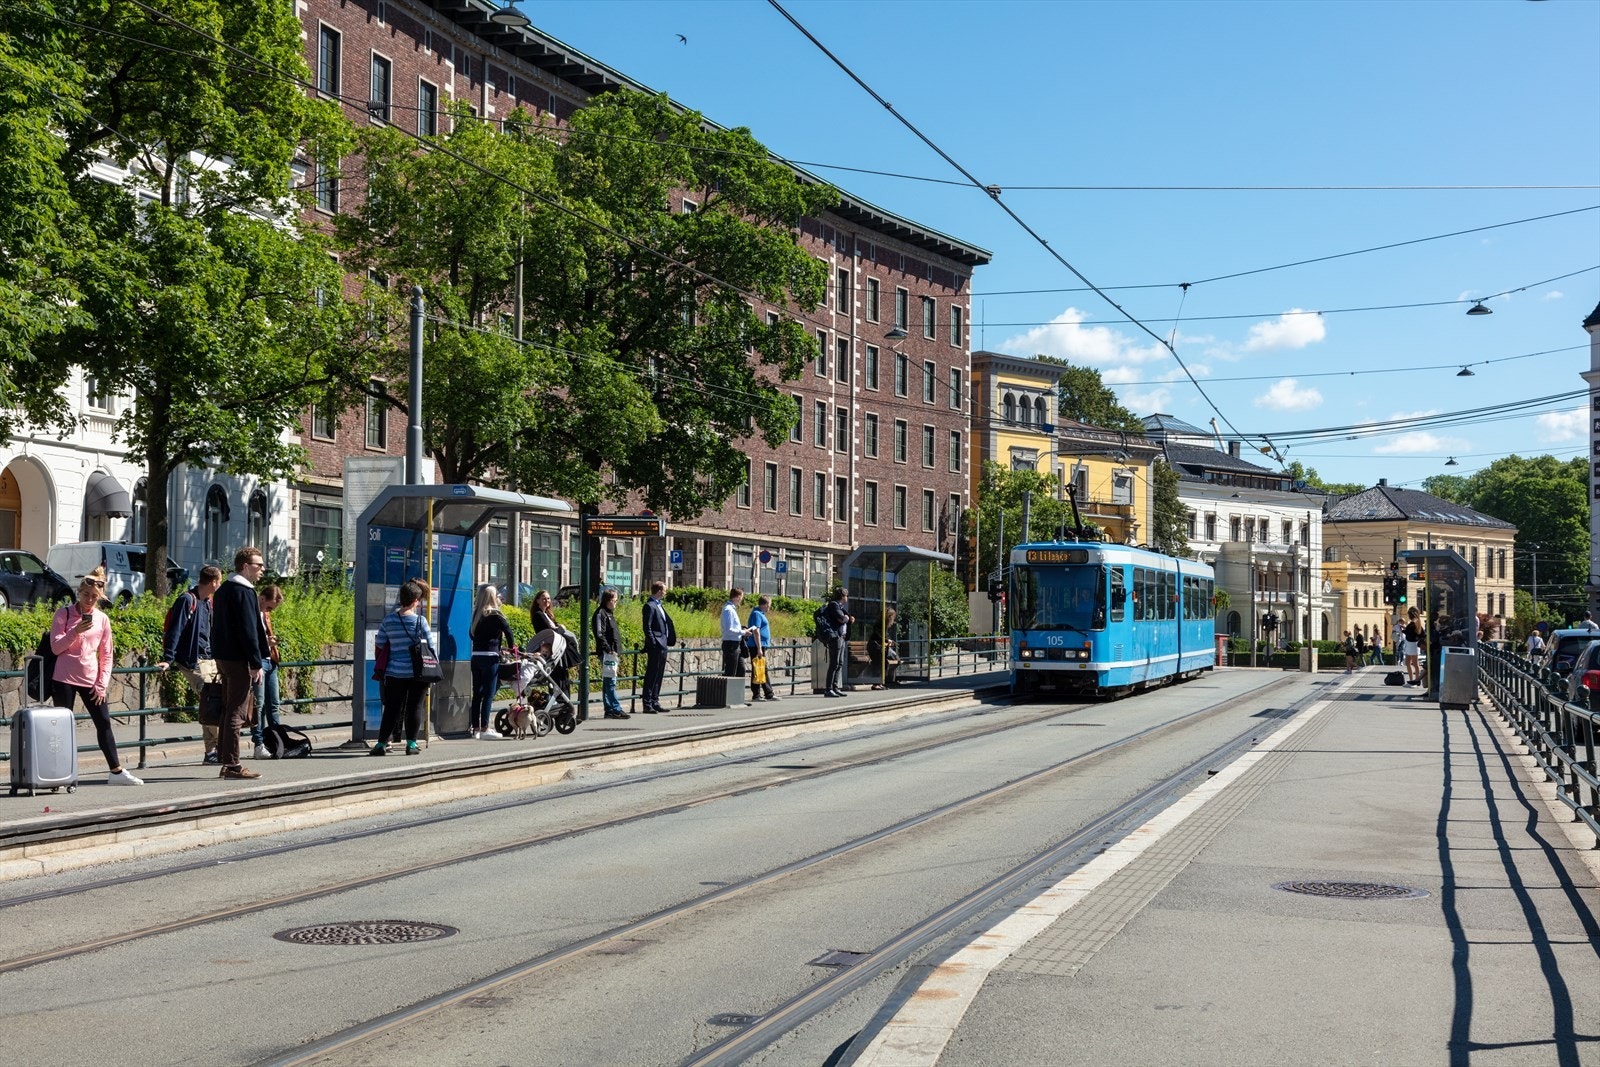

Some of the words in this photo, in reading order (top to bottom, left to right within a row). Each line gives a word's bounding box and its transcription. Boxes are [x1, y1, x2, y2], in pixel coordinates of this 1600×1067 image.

[369, 528, 381, 541] Solli
[672, 552, 680, 562] P
[1028, 550, 1037, 561] 13
[778, 563, 785, 572] P
[1046, 635, 1064, 646] 105
